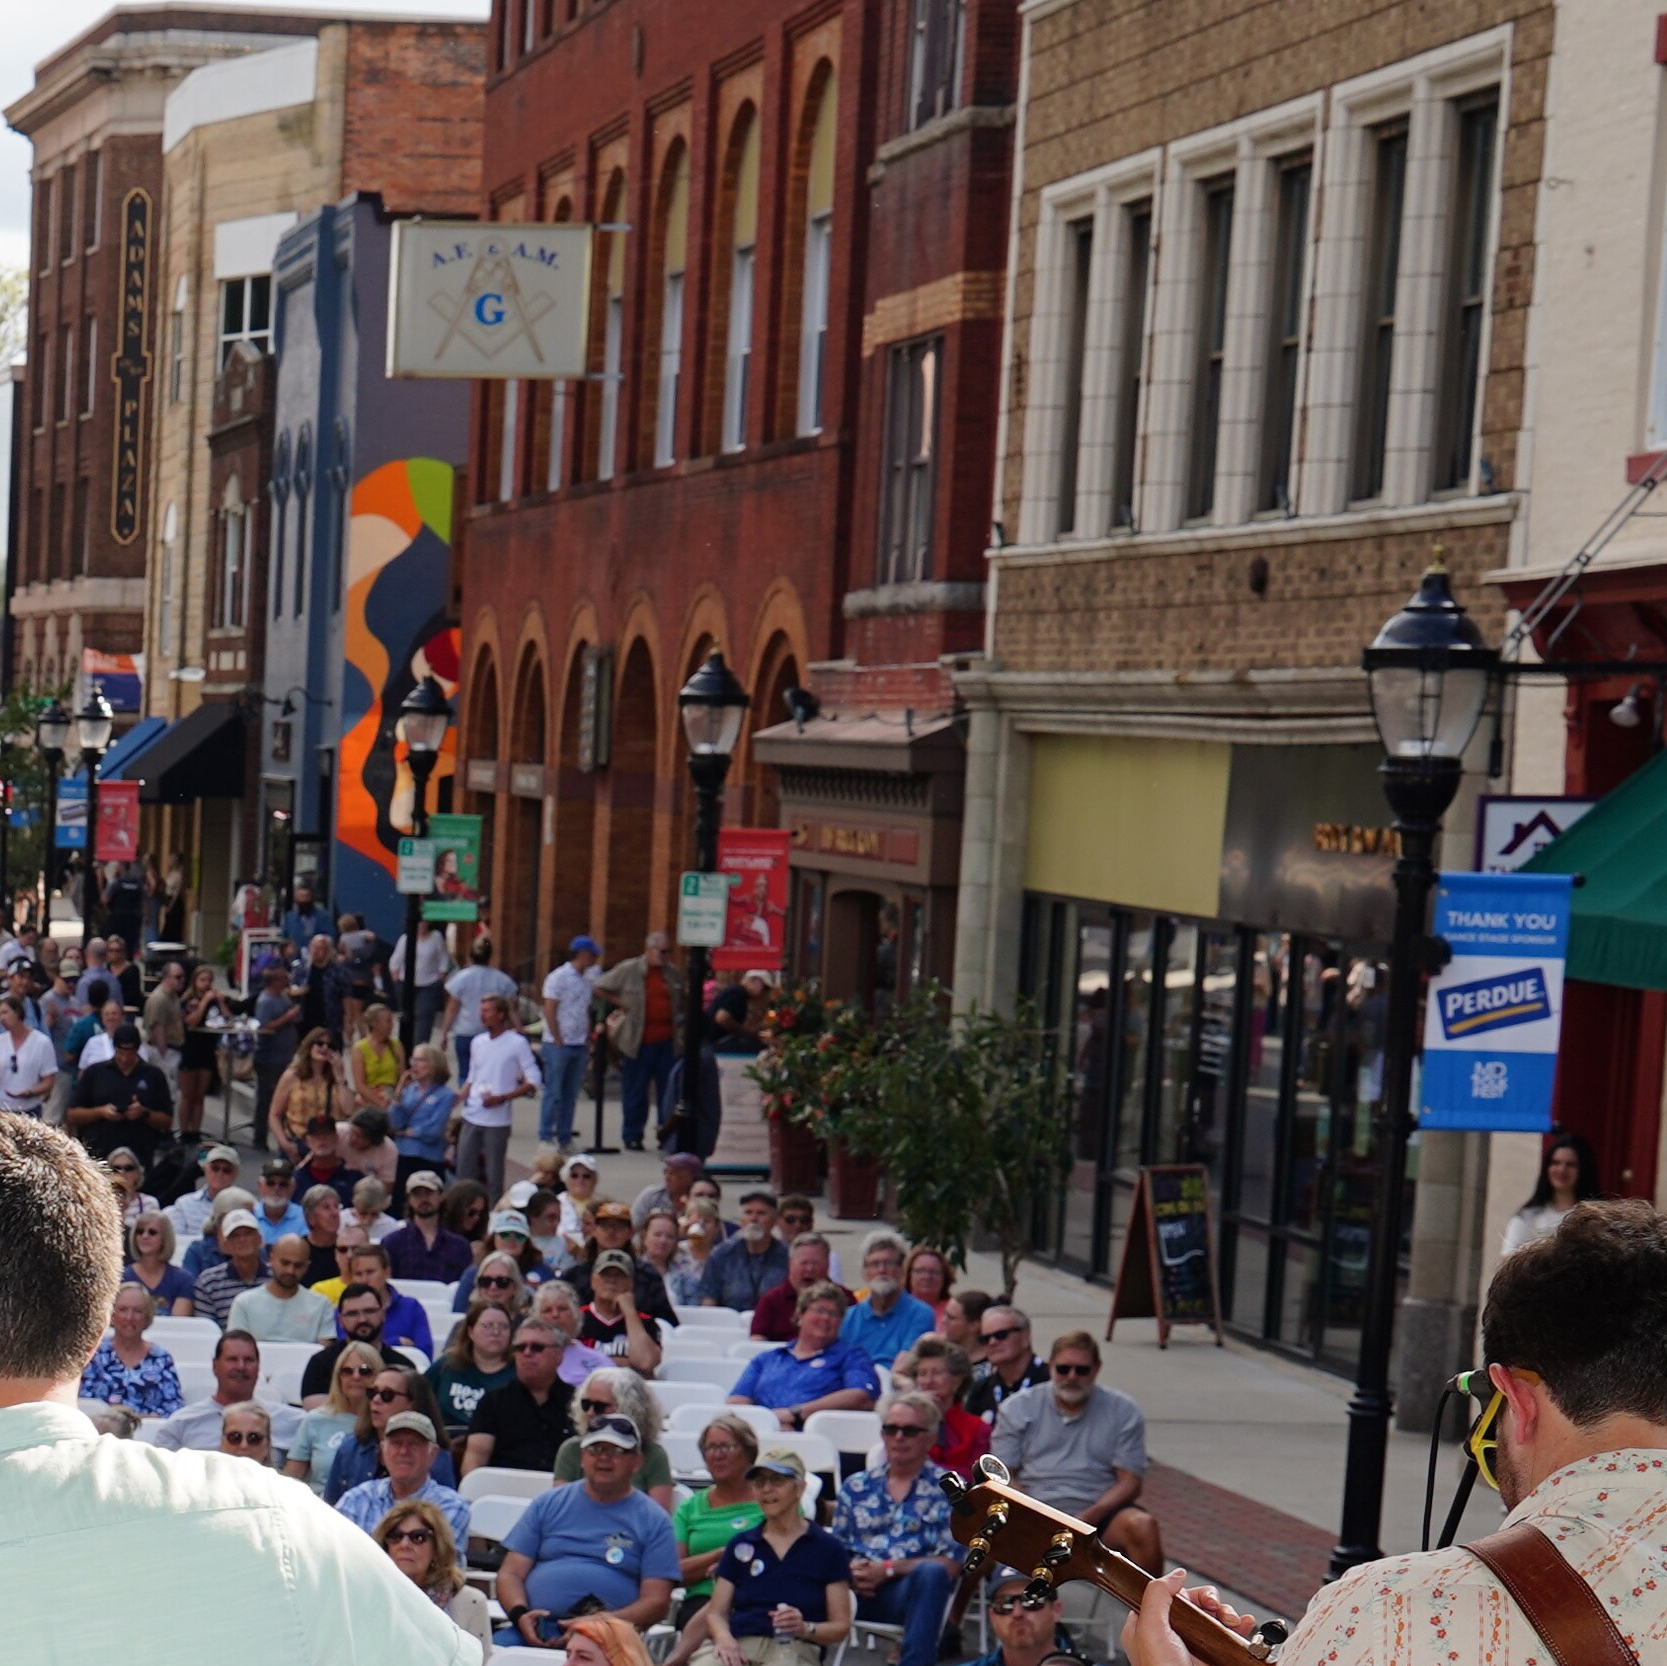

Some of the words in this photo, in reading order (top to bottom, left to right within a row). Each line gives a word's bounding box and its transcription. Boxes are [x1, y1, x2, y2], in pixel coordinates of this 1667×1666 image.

[127, 219, 146, 337] ADAMS
[474, 292, 506, 326] G
[120, 400, 139, 516] PLAZA
[1447, 911, 1509, 929] THANK
[1514, 912, 1557, 931] YOU
[1446, 978, 1539, 1019] PERDUE
